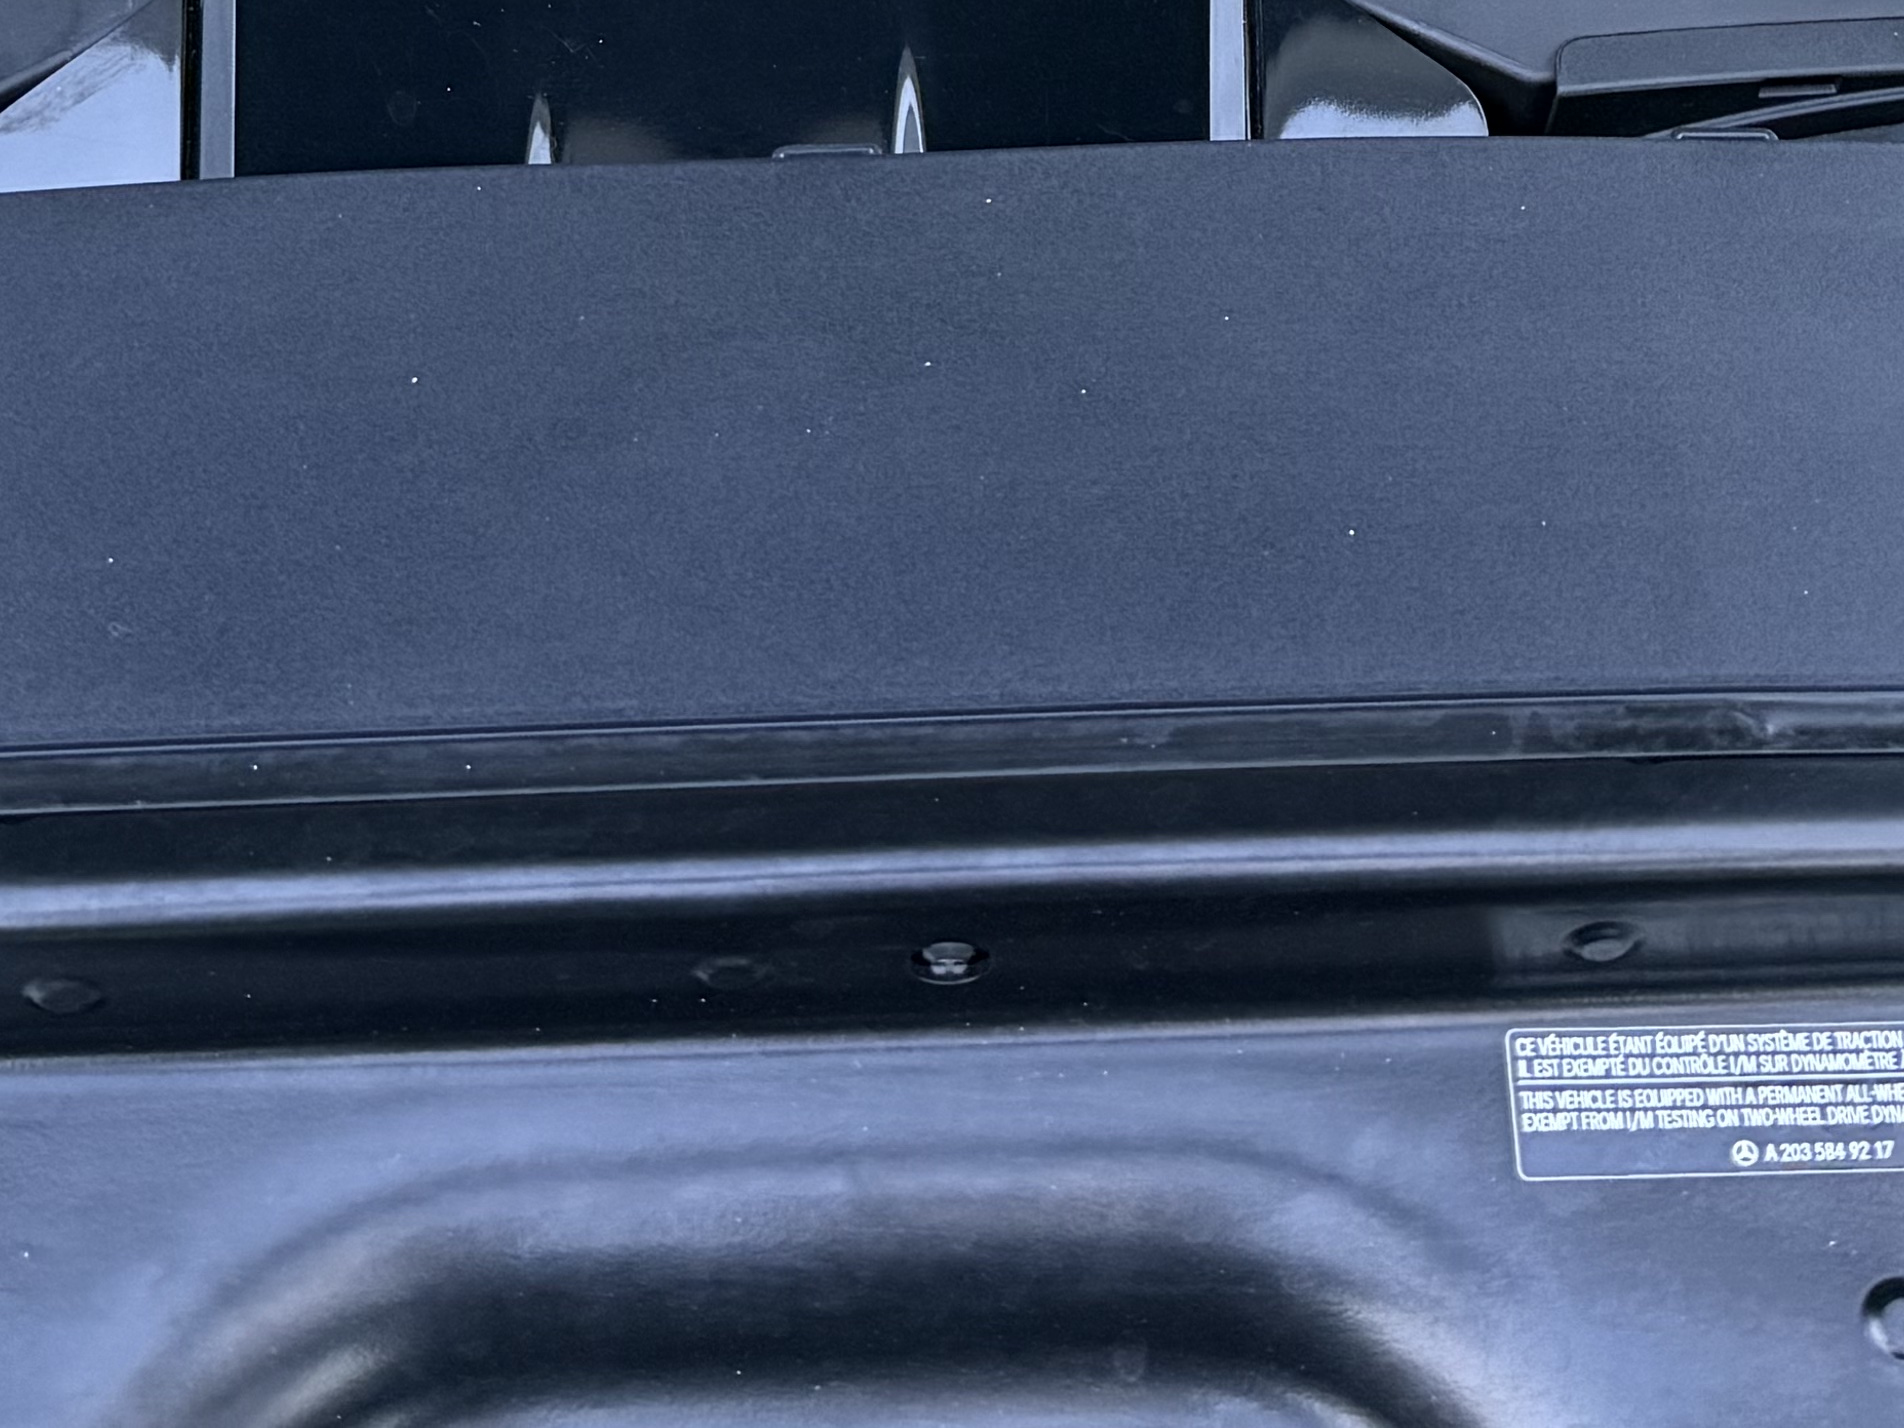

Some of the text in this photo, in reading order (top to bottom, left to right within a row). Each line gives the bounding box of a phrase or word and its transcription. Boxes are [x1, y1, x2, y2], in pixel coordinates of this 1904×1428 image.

[1516, 1036, 1536, 1056] CE
[1539, 1034, 1608, 1056] VÉHICULE
[1609, 1032, 1653, 1054] ÉTANT
[1655, 1031, 1706, 1053] ÉQUIPÉ
[1747, 1029, 1811, 1051] SYSTÈME
[1813, 1031, 1832, 1050] DE
[1834, 1030, 1902, 1049] TRACTION
[1533, 1058, 1560, 1077] EST
[1563, 1055, 1625, 1077] EXEMPTÉ
[1628, 1057, 1650, 1075] DU
[1652, 1054, 1727, 1075] CONTRÔLE
[1730, 1055, 1757, 1075] I/M
[1760, 1054, 1790, 1073] SUR
[1792, 1050, 1897, 1073] DYNAMOMÈTRE
[1519, 1091, 1554, 1109] THIS
[1557, 1090, 1616, 1108] VEHICLE
[1618, 1089, 1633, 1107] IS
[1635, 1088, 1703, 1107] EQUIPPED
[1705, 1087, 1742, 1106] WITH
[1746, 1087, 1757, 1104] A
[1758, 1084, 1845, 1104] PERMANENT
[1521, 1112, 1579, 1132] EXEMPT
[1581, 1111, 1623, 1130] FROM
[1626, 1110, 1654, 1131] I/M
[1656, 1109, 1715, 1129] TESTING
[1717, 1108, 1738, 1127] ON
[1740, 1105, 1825, 1126] TWO-WHEEL
[1827, 1105, 1870, 1126] DRIVE
[1764, 1140, 1895, 1162] A 203 584 92 17
